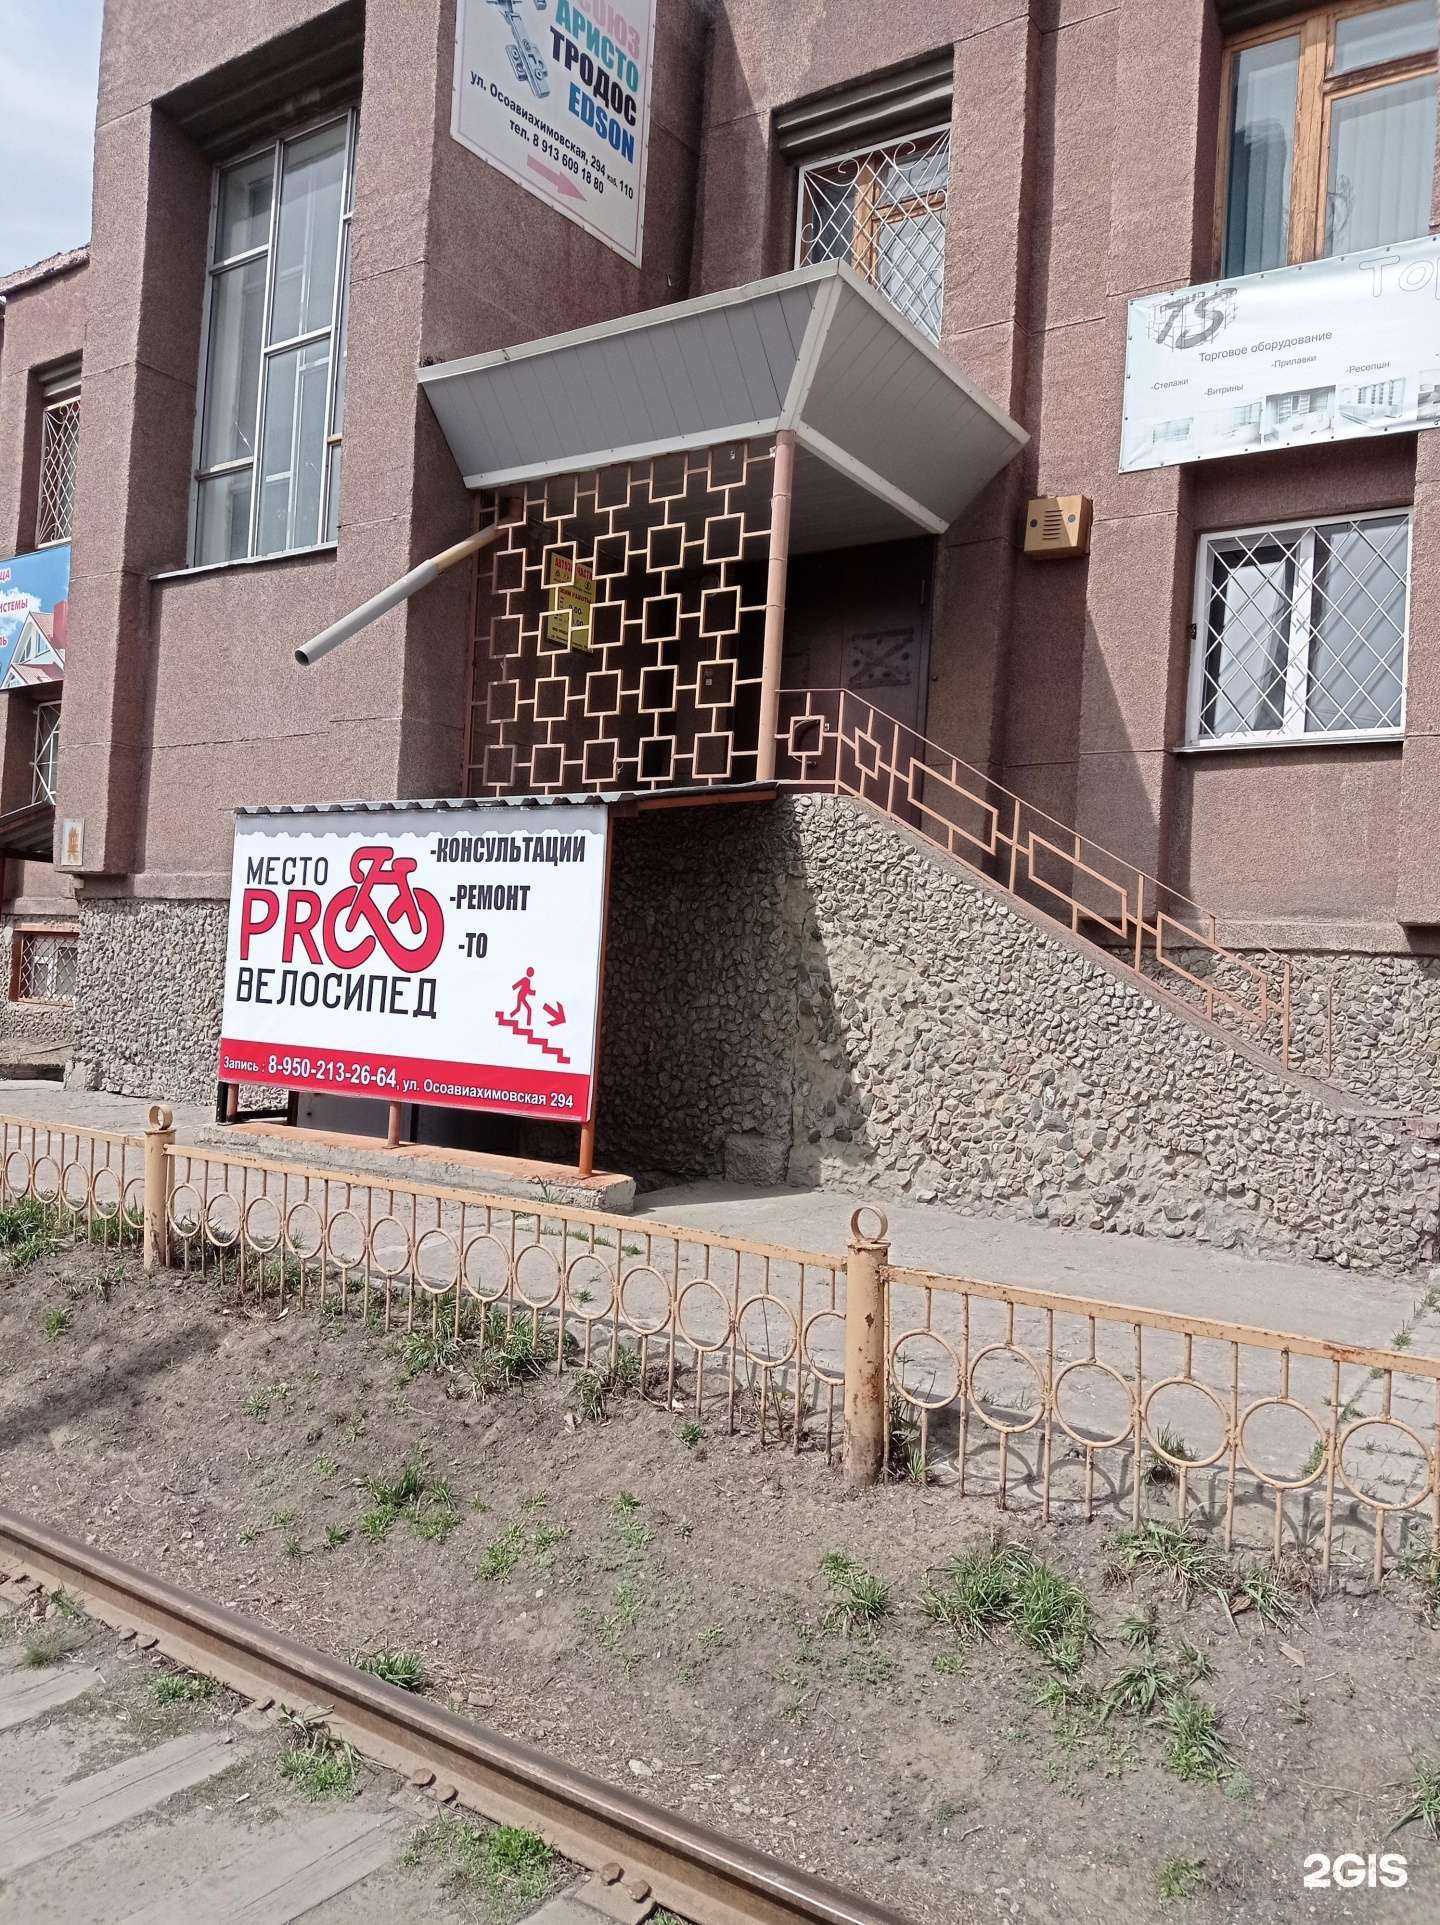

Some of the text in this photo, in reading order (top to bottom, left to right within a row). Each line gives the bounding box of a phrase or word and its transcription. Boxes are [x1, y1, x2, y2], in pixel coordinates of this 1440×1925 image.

[556, 0, 639, 92] АРИСТО
[550, 26, 637, 127] ТРОДОС
[470, 70, 487, 91] ул.
[490, 83, 588, 165] Осоавиахимовская,
[590, 155, 606, 176] 294
[619, 180, 634, 200] 110
[569, 81, 635, 165] EDSON
[509, 120, 604, 194] тел. 8 913 609 18 80
[1359, 254, 1440, 300] То
[1199, 332, 1333, 362] Торговое оборудование
[1271, 355, 1317, 368] -Прилавки
[1204, 384, 1244, 396] -Витрины
[247, 857, 329, 885] МЕСТО
[430, 836, 586, 866] -КОНСУЛЬТАЦИИ
[450, 885, 531, 911] -РЕМОНТ
[458, 932, 488, 958] -ТО
[236, 967, 437, 1020] ВЕЛОСИПЕД
[268, 1055, 400, 1090] 8-950-213-26-64,
[402, 1079, 420, 1093] ул.
[424, 1079, 547, 1105] Осоавиахимовская
[550, 1092, 574, 1109] 294
